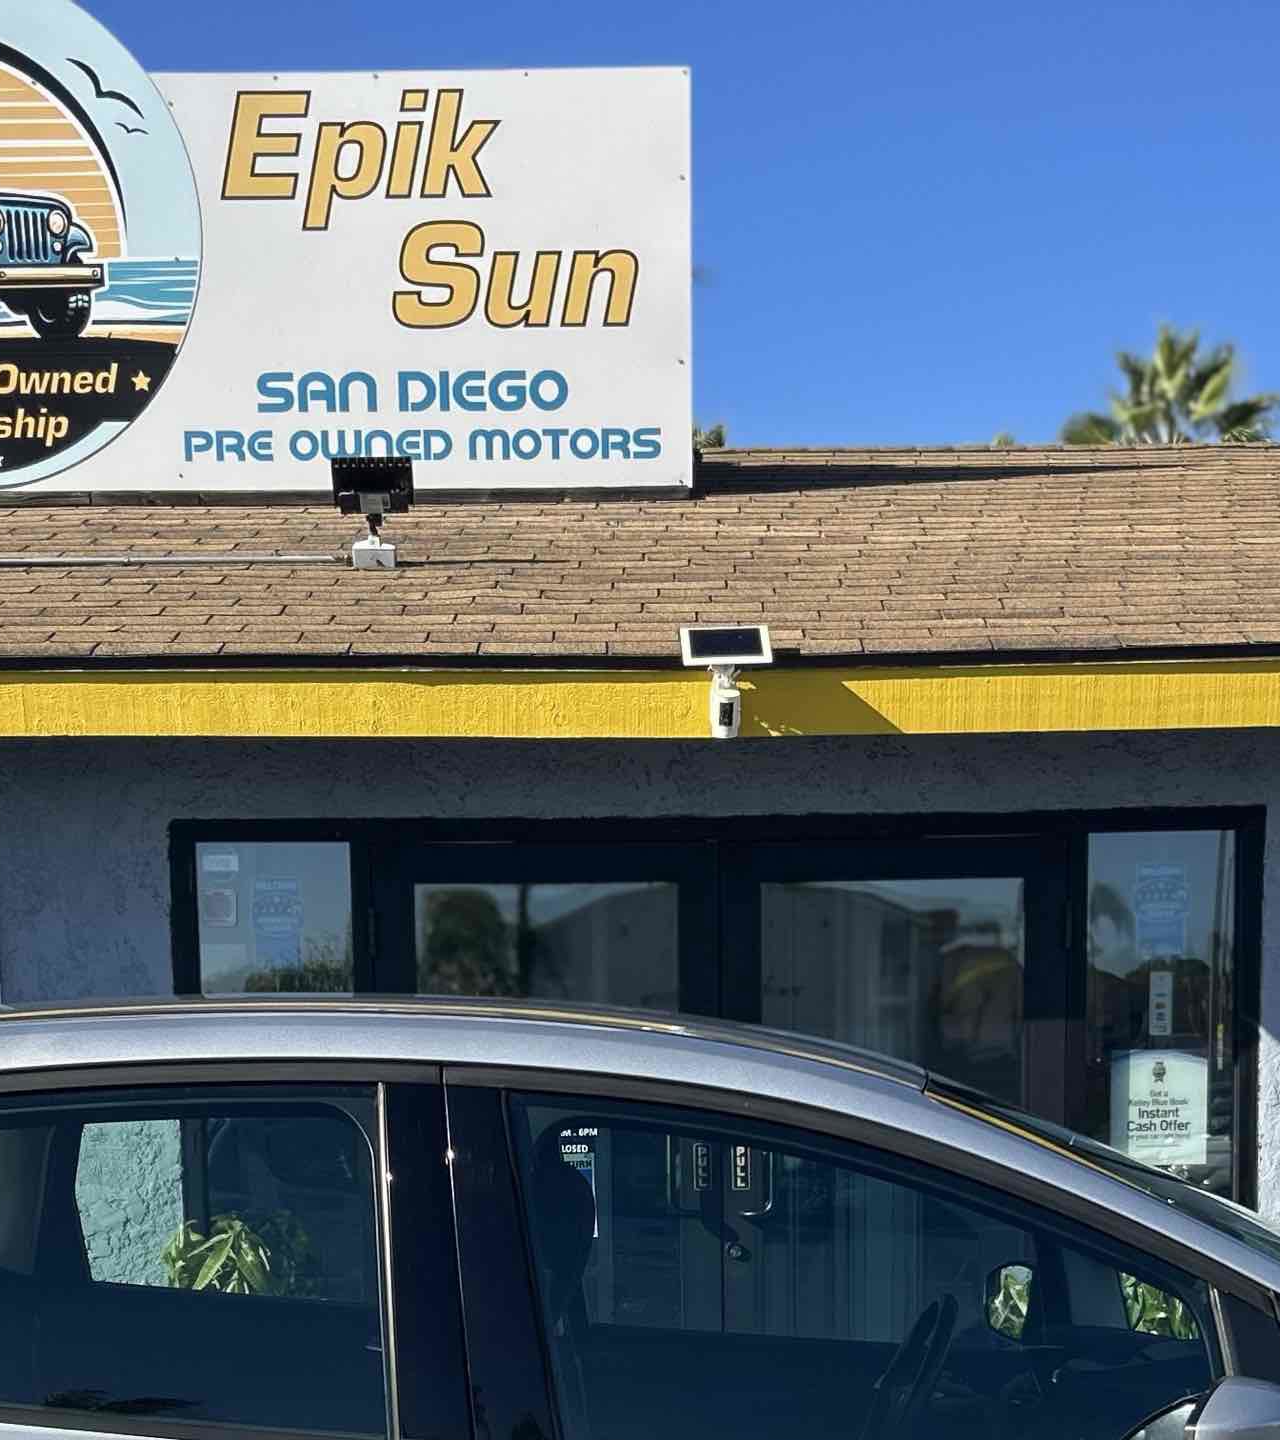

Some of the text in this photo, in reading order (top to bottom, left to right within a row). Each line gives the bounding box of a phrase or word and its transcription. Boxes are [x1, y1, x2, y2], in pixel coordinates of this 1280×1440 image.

[221, 88, 502, 231] Epik
[392, 219, 639, 329] Sun
[256, 369, 569, 413] SAN DIEGO
[183, 427, 662, 462] PRE OWNED MOTORS
[1127, 1119, 1192, 1132] Cash Offer
[1138, 1107, 1180, 1119] Instant
[561, 1144, 588, 1152] LOSED
[736, 1146, 746, 1187] PULL
